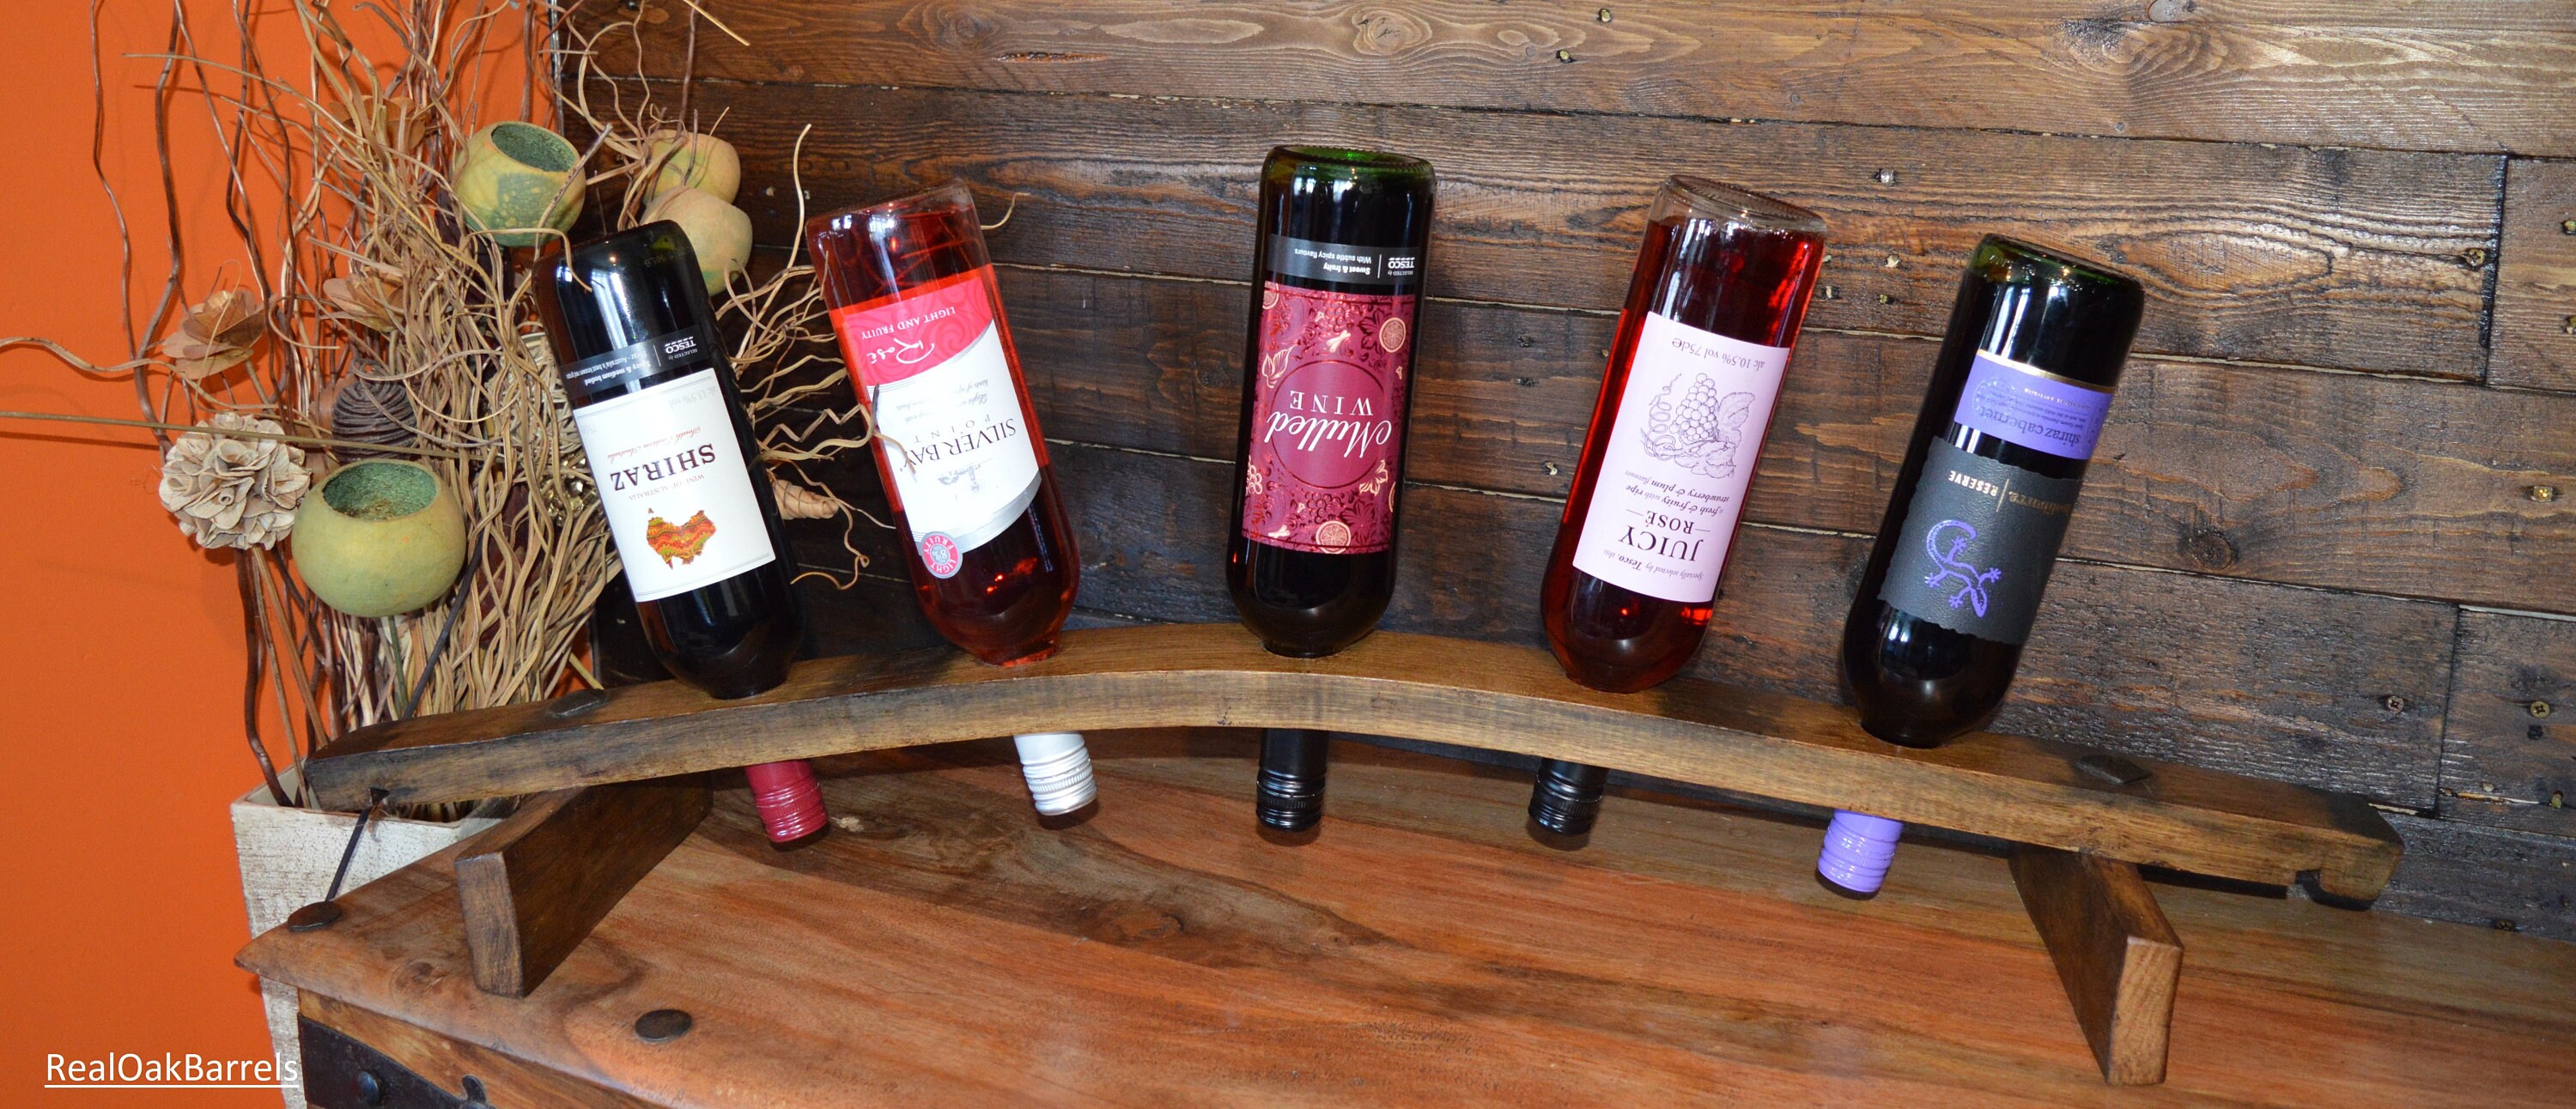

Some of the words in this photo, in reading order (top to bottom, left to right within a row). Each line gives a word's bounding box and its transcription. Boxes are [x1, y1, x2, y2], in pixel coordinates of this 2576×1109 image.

[1294, 248, 1317, 258] flavours
[1336, 253, 1355, 262] subtle
[1323, 262, 1340, 272] fruity
[1348, 265, 1370, 274] Sweet
[922, 306, 955, 323] LIGHT
[896, 317, 920, 330] AND
[860, 324, 894, 339] FRUITY
[665, 339, 696, 354] TESCO
[866, 337, 934, 364] Rosé
[1703, 348, 1717, 358] vol
[673, 348, 697, 359] SELECTED
[1722, 352, 1751, 367] 10.5%
[1753, 360, 1765, 370] alc
[583, 374, 602, 386] bodied
[601, 368, 625, 379] medium
[1288, 390, 1374, 415] WINE
[1979, 406, 2043, 434] cabernet
[913, 414, 990, 443] POINT
[1263, 411, 1391, 458] Mulled
[941, 418, 1016, 457] SILVER
[2044, 427, 2081, 445] shiraz
[606, 445, 641, 464] Australia
[901, 443, 940, 467] BAY
[610, 443, 715, 491] SHIRAZ
[1625, 470, 1651, 484] flavours
[1947, 470, 1998, 496] RESERVE
[628, 484, 669, 500] AUSTRALIA
[1625, 484, 1643, 495] ripe
[1650, 480, 1675, 492] plum
[1675, 488, 1685, 496] &
[1644, 491, 1660, 500] with
[1687, 488, 1728, 502] strawberry
[1661, 495, 1690, 510] fruity
[1688, 504, 1698, 512] &
[1698, 506, 1720, 515] fresh
[1643, 510, 1694, 534] ROSÉ
[923, 536, 953, 553] FRUITY
[1618, 524, 1703, 561] JUICY
[932, 548, 946, 560] 8%
[1603, 548, 1615, 558] this
[929, 560, 956, 572] LIGHT
[1645, 562, 1653, 572] by
[1653, 566, 1679, 577] selected
[1679, 569, 1703, 579] Specially
